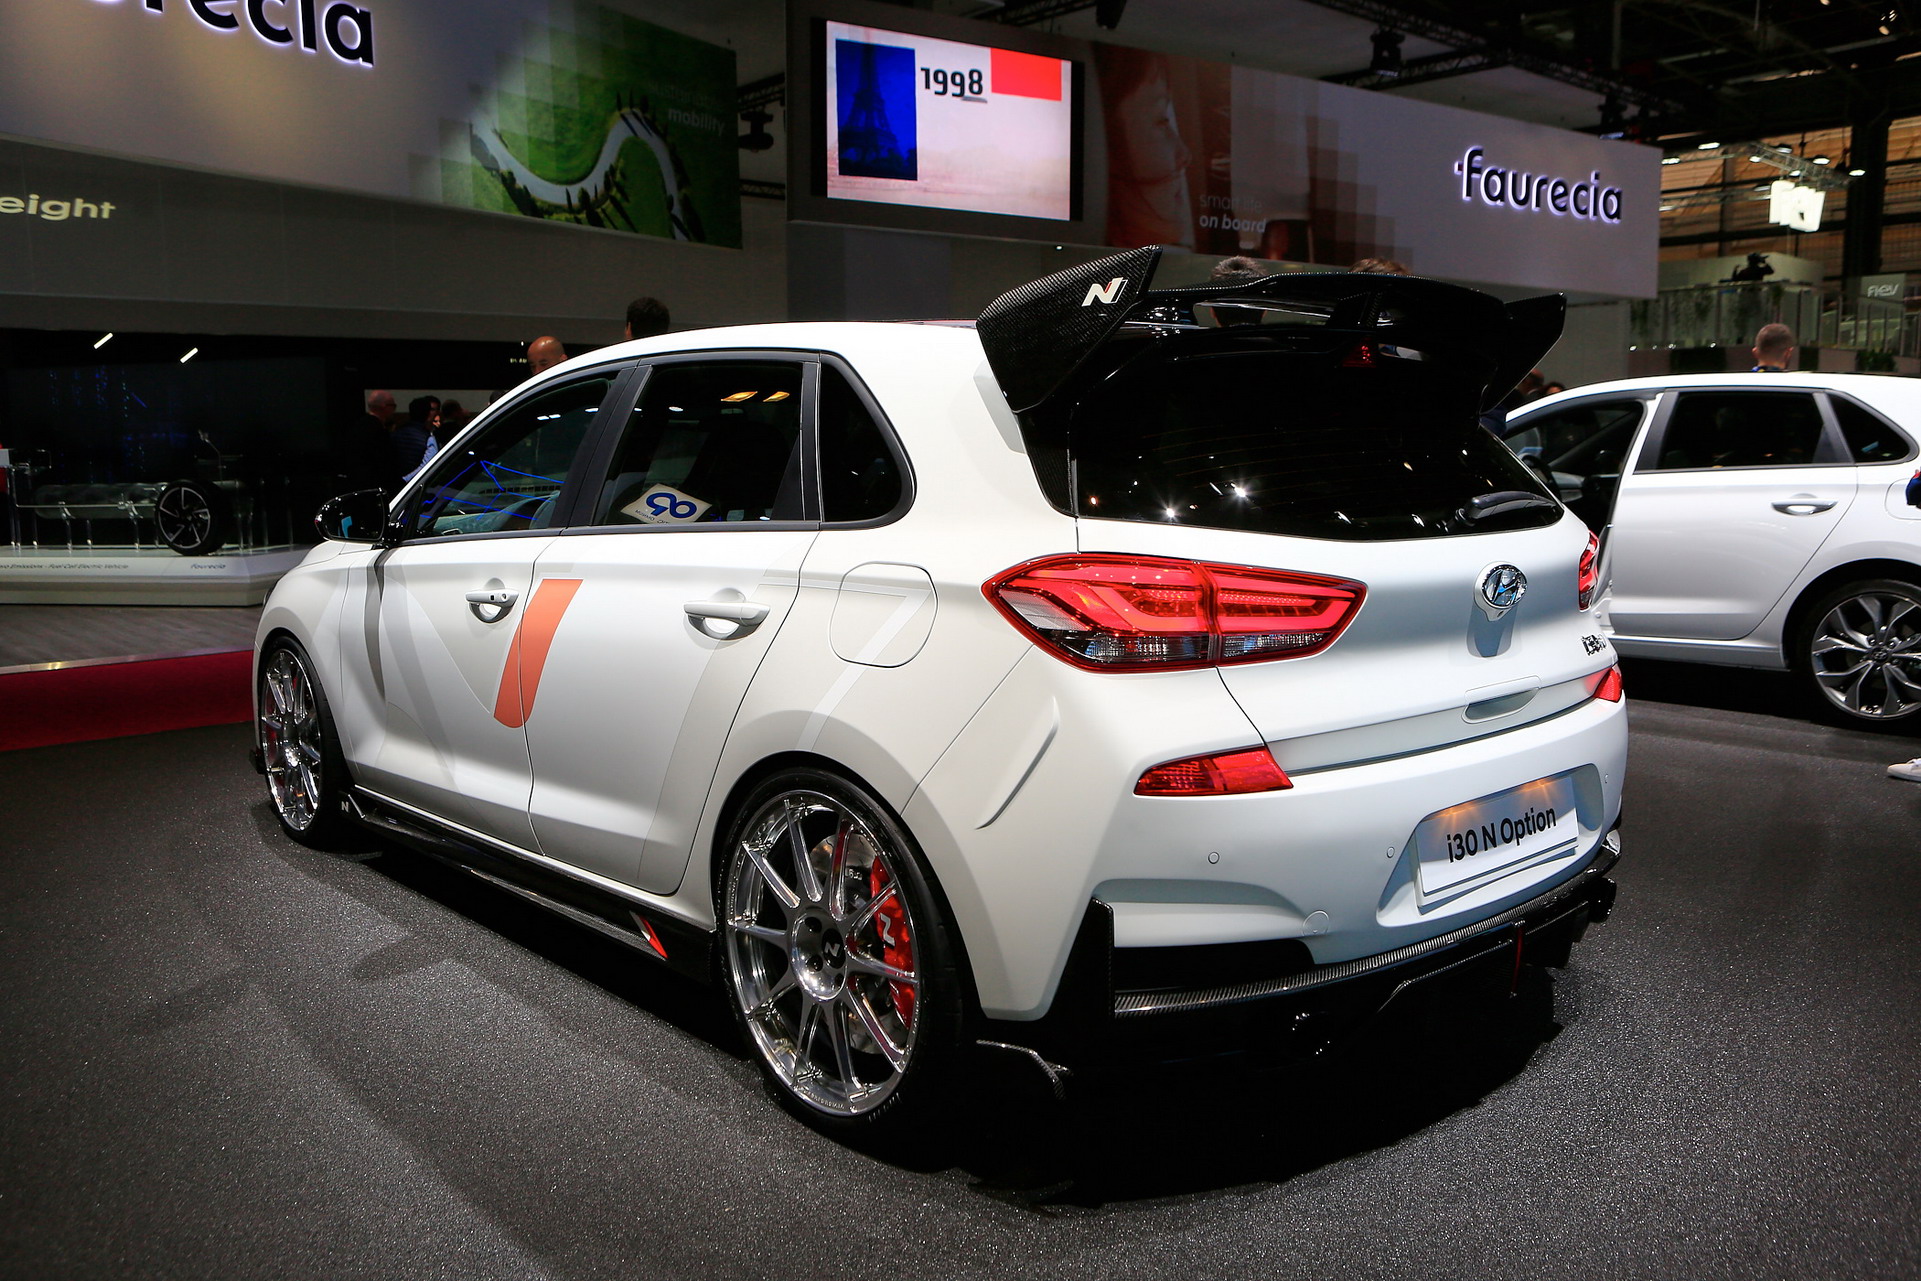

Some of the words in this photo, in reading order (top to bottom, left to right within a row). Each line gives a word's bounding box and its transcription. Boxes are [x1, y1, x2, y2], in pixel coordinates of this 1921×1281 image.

[144, 0, 374, 67] ecia
[920, 67, 983, 97] 1998
[667, 108, 725, 137] mobility
[1454, 146, 1622, 224] faurecia
[1199, 215, 1218, 229] on
[1221, 213, 1266, 233] board
[1082, 277, 1128, 307] N
[341, 801, 349, 812] N
[1446, 829, 1478, 863] i30
[1482, 823, 1497, 852] N
[1500, 807, 1557, 846] Option
[824, 941, 841, 957] N
